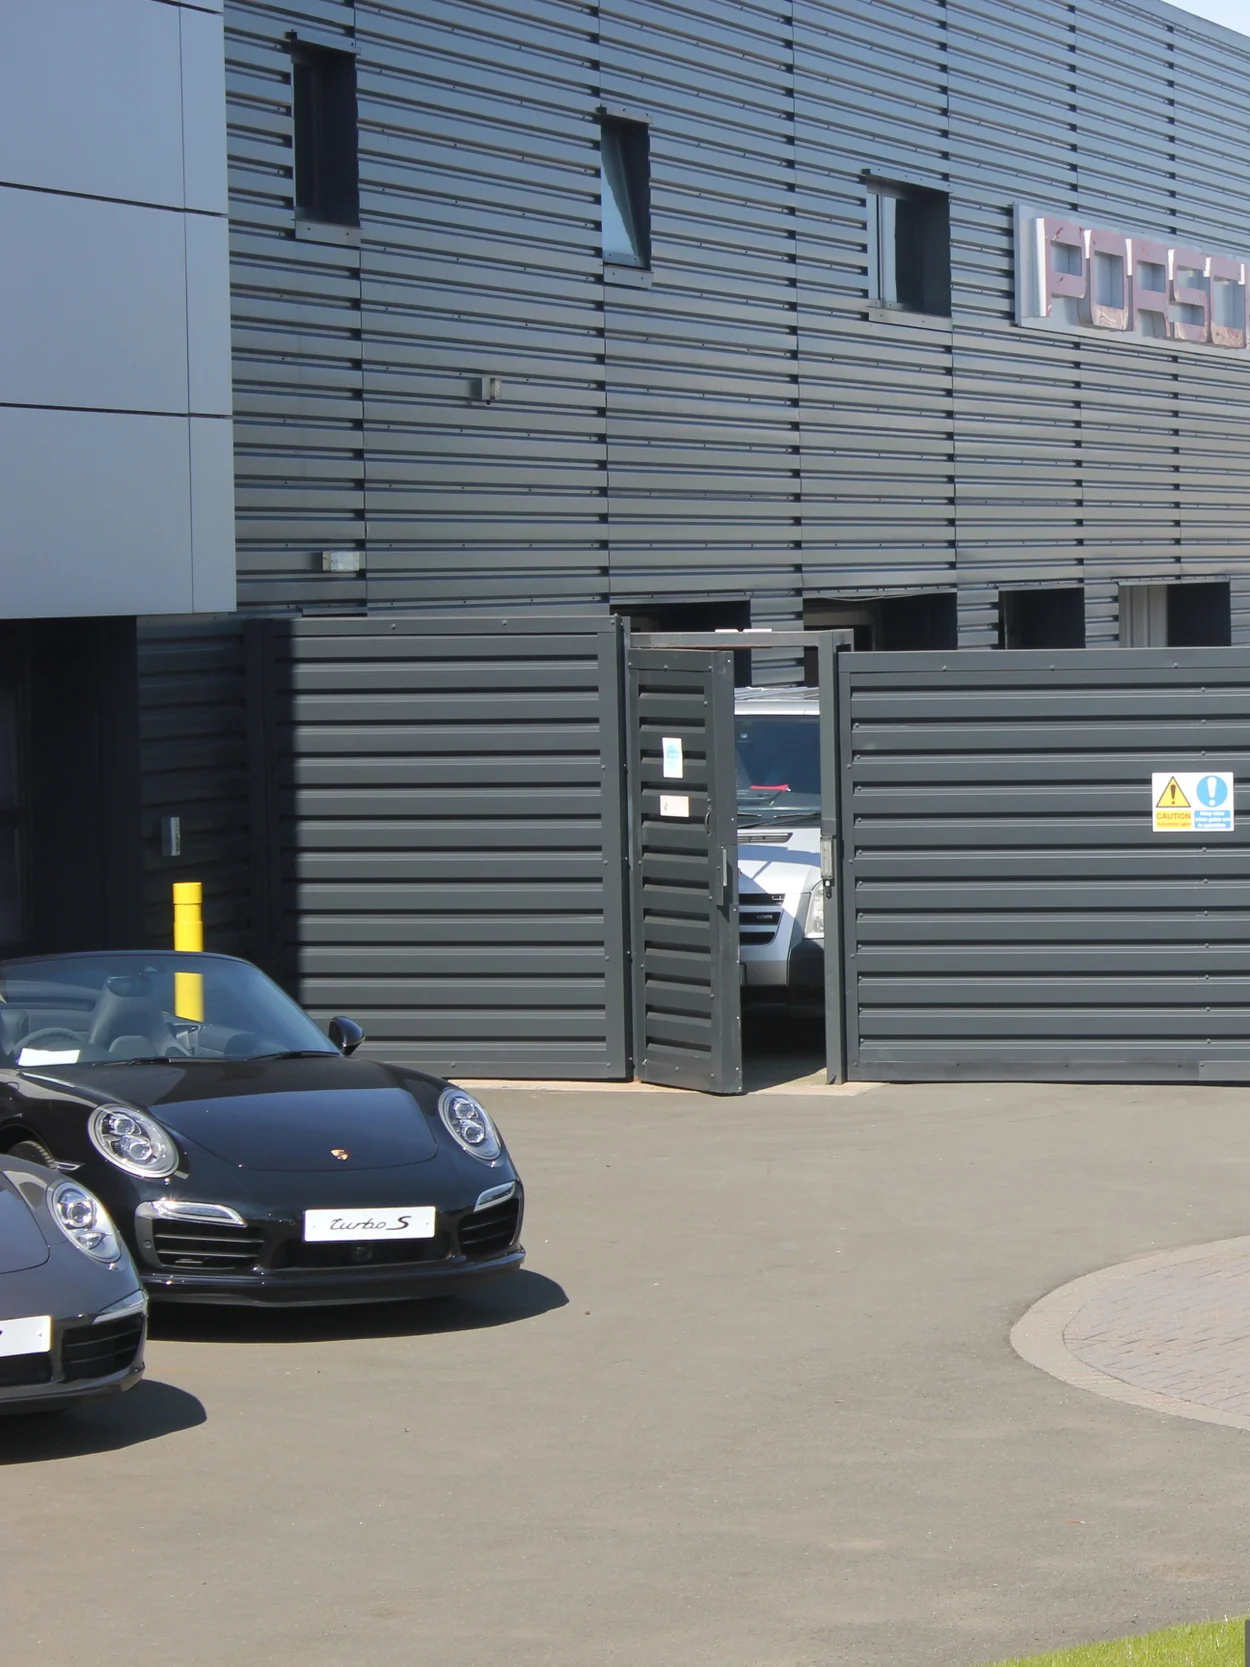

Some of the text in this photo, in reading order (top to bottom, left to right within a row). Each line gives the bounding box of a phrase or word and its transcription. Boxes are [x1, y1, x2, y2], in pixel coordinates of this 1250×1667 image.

[1156, 812, 1191, 820] CAUTION
[330, 1215, 412, 1231] turbo S
